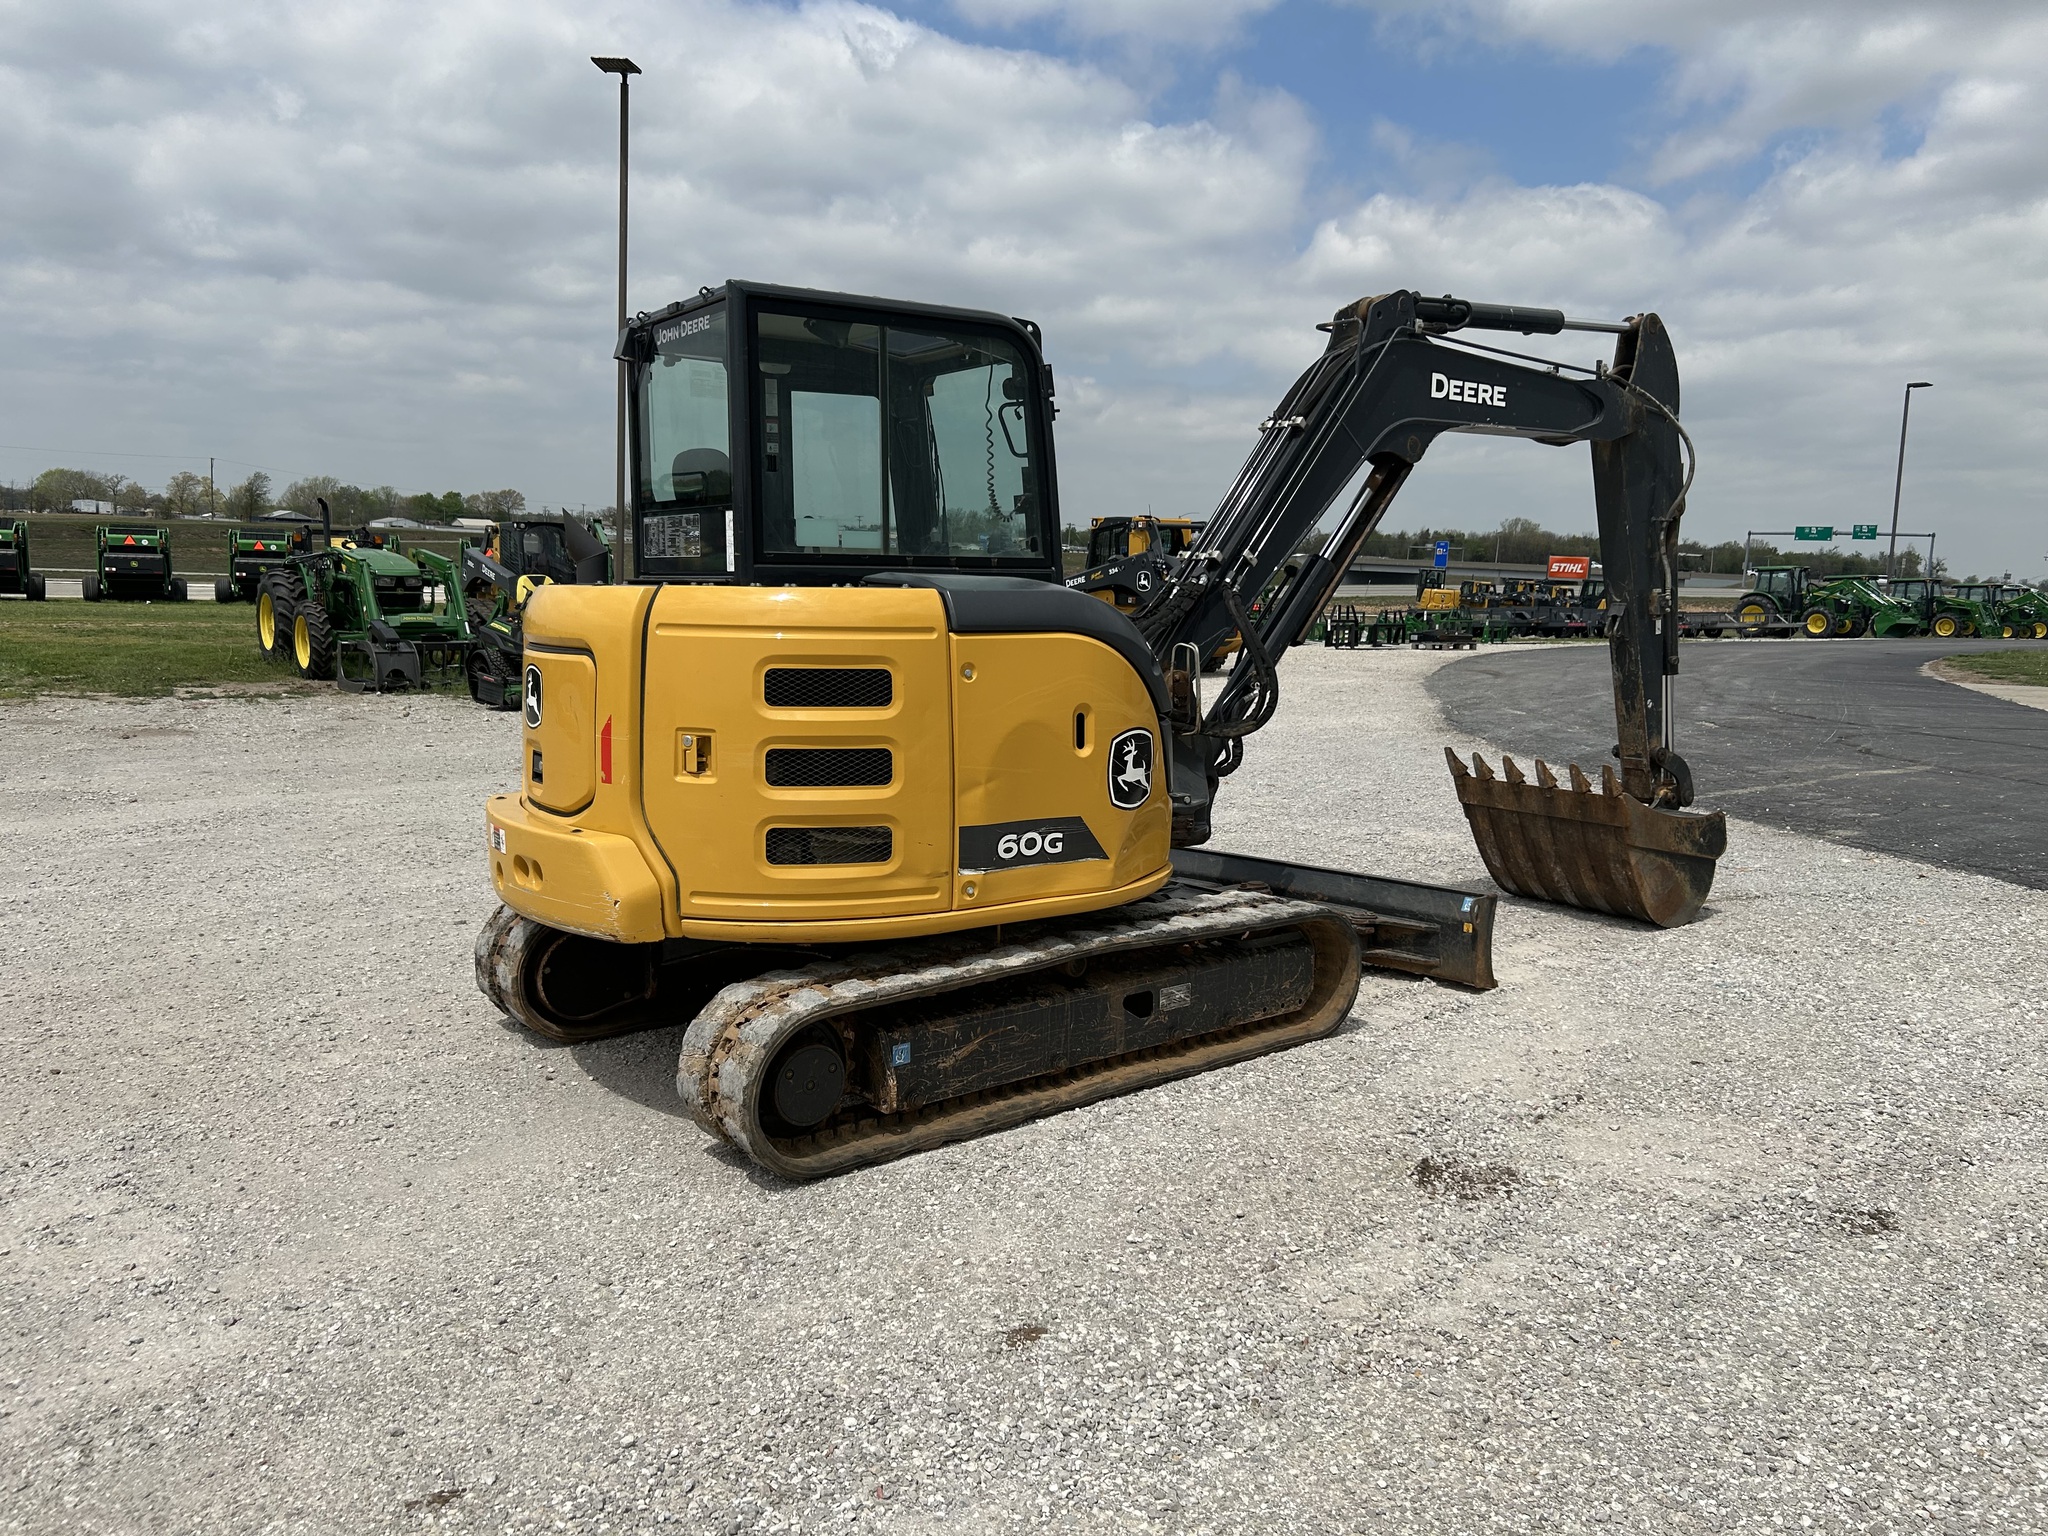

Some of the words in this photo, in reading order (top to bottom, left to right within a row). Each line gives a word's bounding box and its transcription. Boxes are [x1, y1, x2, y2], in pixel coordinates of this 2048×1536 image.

[657, 326, 680, 346] JOHN
[681, 315, 711, 338] DEERE
[1431, 372, 1507, 408] DEERE
[481, 563, 496, 581] DEERE
[1550, 562, 1585, 574] STIHL
[1065, 575, 1087, 588] DEERE
[997, 831, 1064, 859] 60G
